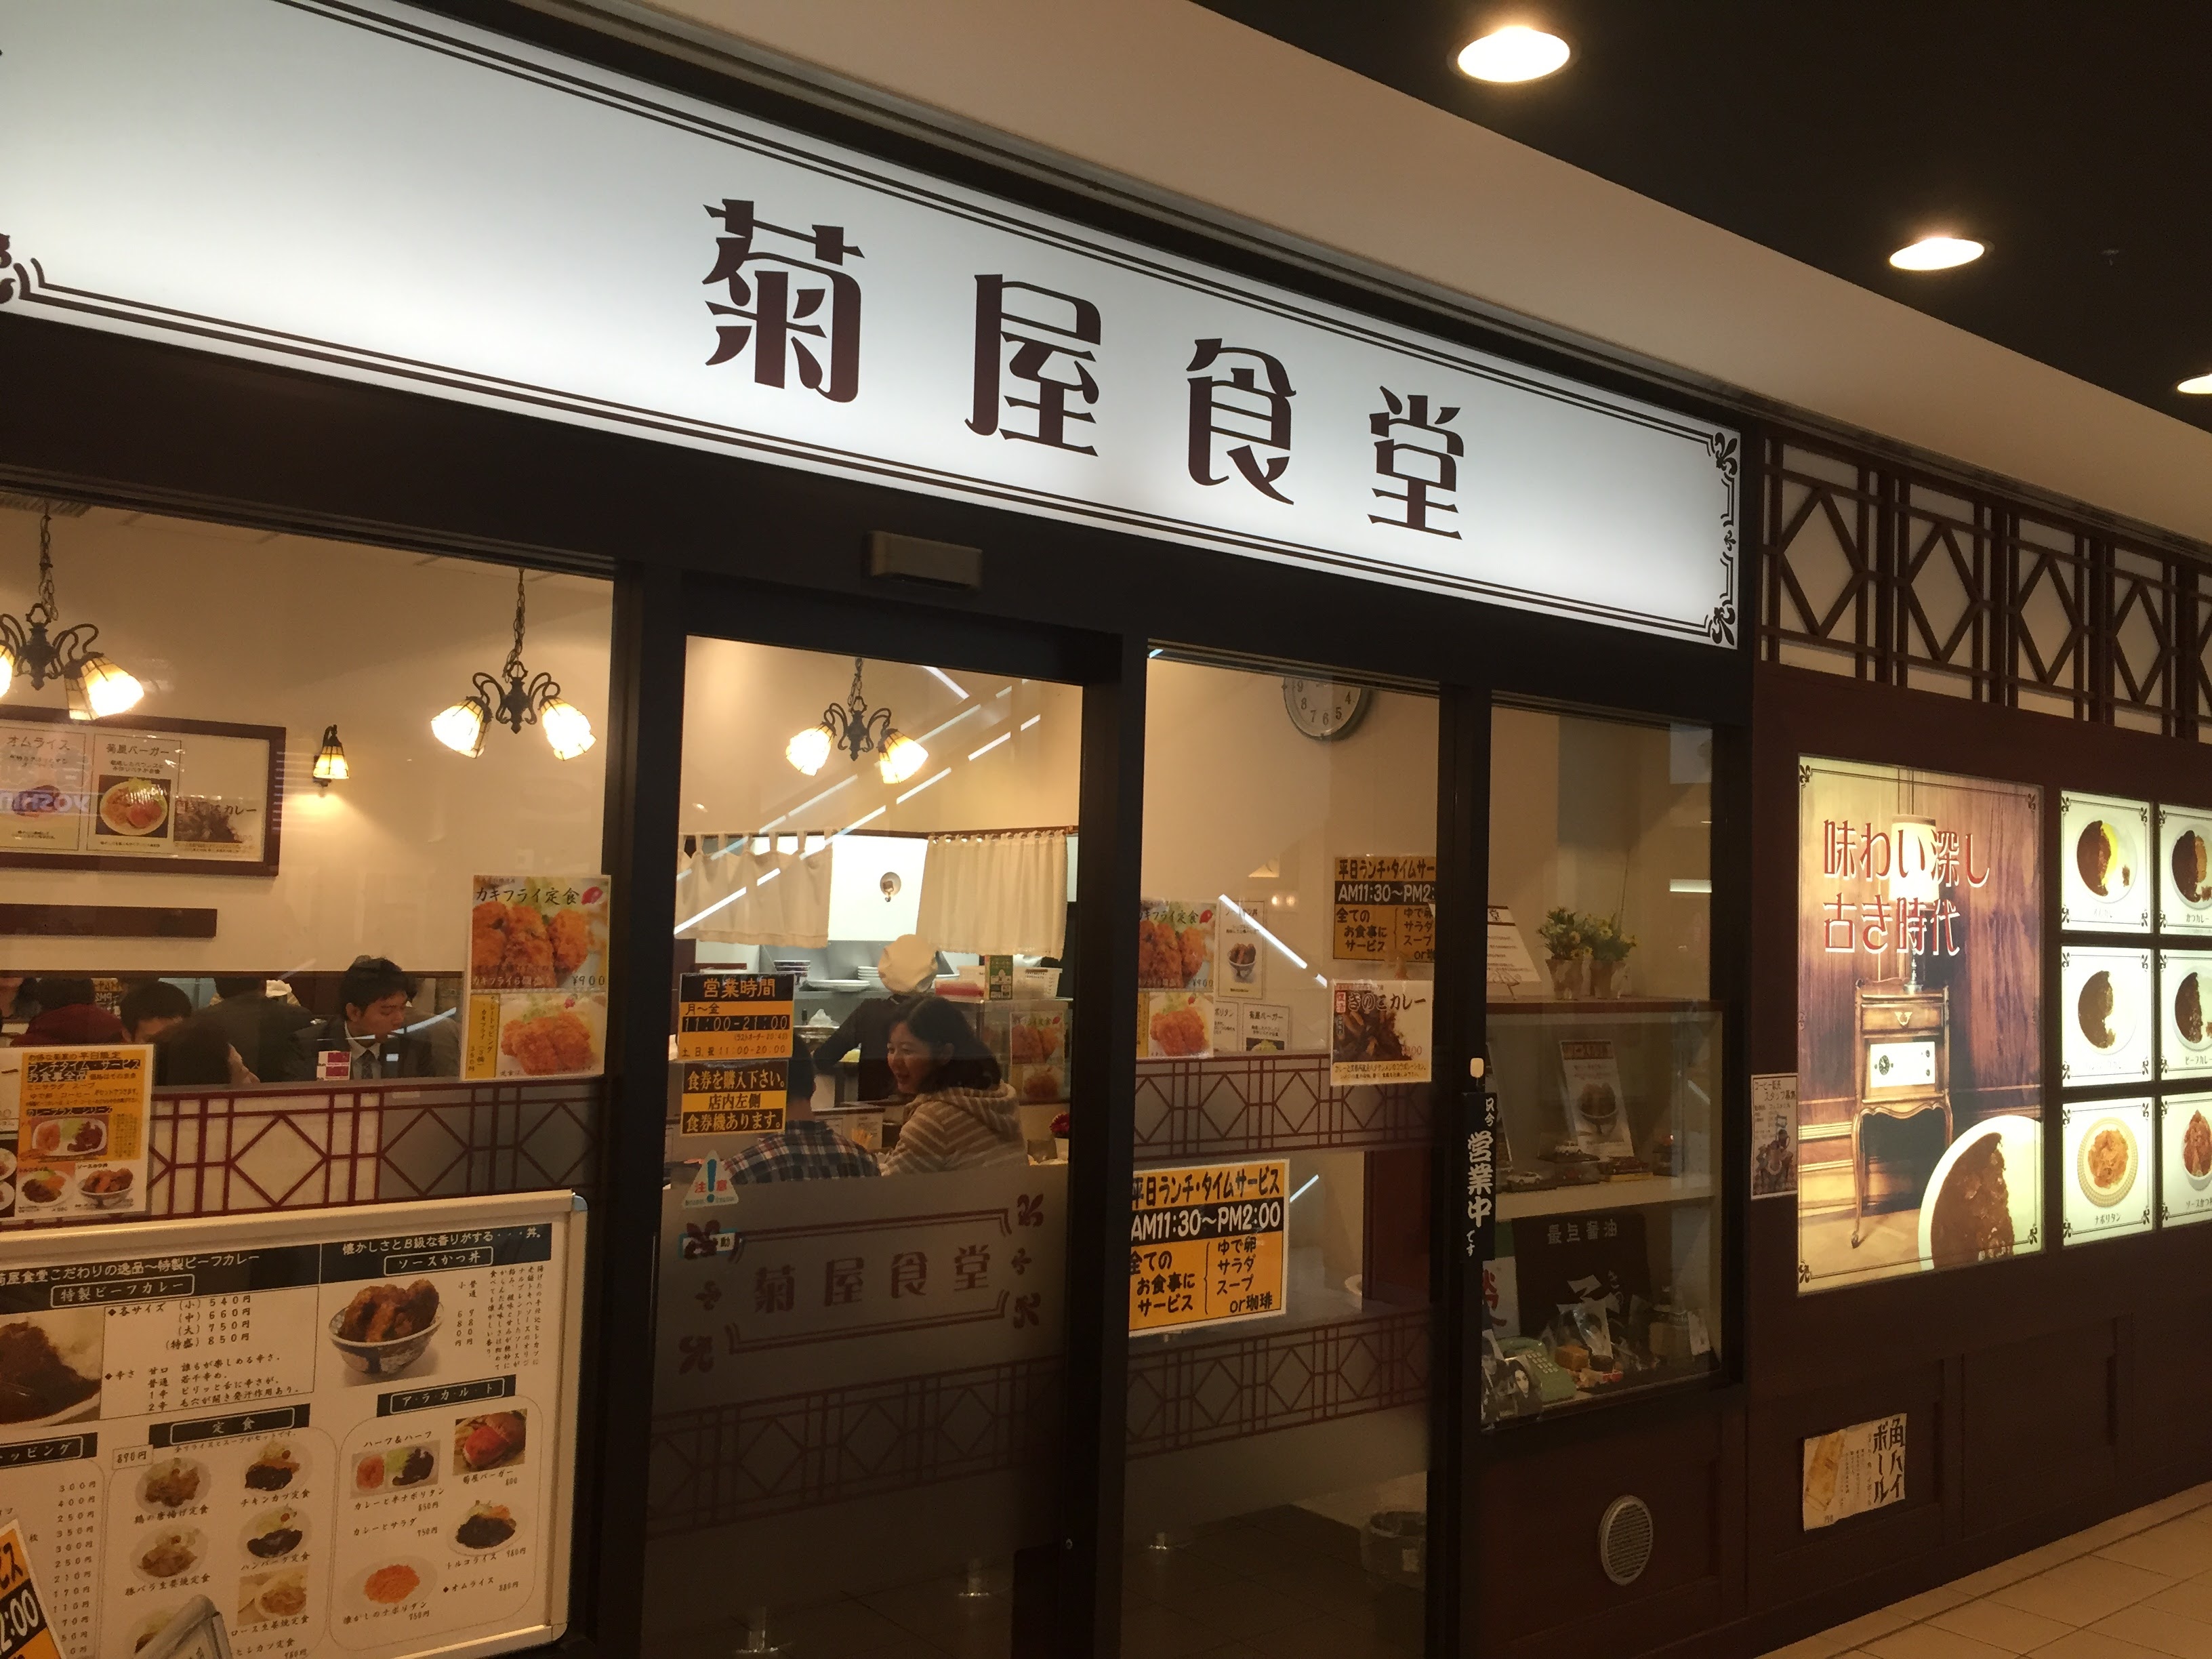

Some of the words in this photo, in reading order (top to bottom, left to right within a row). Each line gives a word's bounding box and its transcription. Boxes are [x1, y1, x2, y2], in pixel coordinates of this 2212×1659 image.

[702, 199, 1465, 541] 菊屋食堂
[1301, 697, 1307, 710] 8
[1345, 691, 1351, 704] 4
[1310, 710, 1316, 722] 7
[1322, 712, 1329, 725] 6
[1335, 707, 1342, 720] 5
[7, 735, 70, 751] オムライス
[1823, 819, 1990, 888] 味わい深し
[476, 887, 581, 905] カキフライ定食
[1336, 907, 1370, 924] 全ての
[1822, 891, 1961, 956] 古き時代
[1344, 925, 1387, 939] お食事に
[1345, 939, 1386, 953] サービス
[573, 975, 605, 987] ¥900
[703, 978, 776, 998] 営業時間
[1348, 993, 1427, 1012] きのこカレー
[684, 1016, 788, 1032] 11:00-21:00
[687, 1069, 785, 1091] 食券を購入下さい。
[708, 1092, 761, 1109] 店内左側
[686, 1113, 783, 1134] 食券機あります。
[695, 1179, 728, 1193] 注意
[1467, 1129, 1494, 1228] 営業中
[1218, 1235, 1256, 1255] ゆで卵
[1466, 1229, 1475, 1256] です
[398, 1252, 481, 1270] ソースかつ丼
[1130, 1250, 1172, 1275] 全ての
[1217, 1254, 1256, 1275] サラダ
[754, 1245, 991, 1314] 菊屋食堂
[1136, 1272, 1195, 1296] お食事に
[1216, 1273, 1254, 1295] スープ
[60, 1281, 184, 1303] 特製ビーフカレー
[119, 1303, 166, 1316] 各サイズ
[209, 1295, 251, 1308] 540円
[1137, 1294, 1193, 1317] サービス
[1229, 1290, 1273, 1313] or珈琲
[209, 1308, 251, 1319] 660円
[208, 1319, 251, 1332] 750円
[207, 1332, 250, 1345] 850円
[148, 1376, 169, 1388] 普通
[212, 1416, 256, 1435] 定食
[59, 1480, 96, 1492] 300円
[58, 1495, 96, 1507] 400円
[240, 1488, 311, 1508] チキンカツ定食
[57, 1511, 95, 1523] 250円
[134, 1504, 209, 1525] 鶏の唐揚げ定食
[56, 1525, 94, 1538] 350円
[55, 1540, 94, 1553] 300円
[54, 1555, 92, 1568] 250円
[447, 1552, 497, 1570] トルコライス
[54, 1586, 90, 1598] 170円
